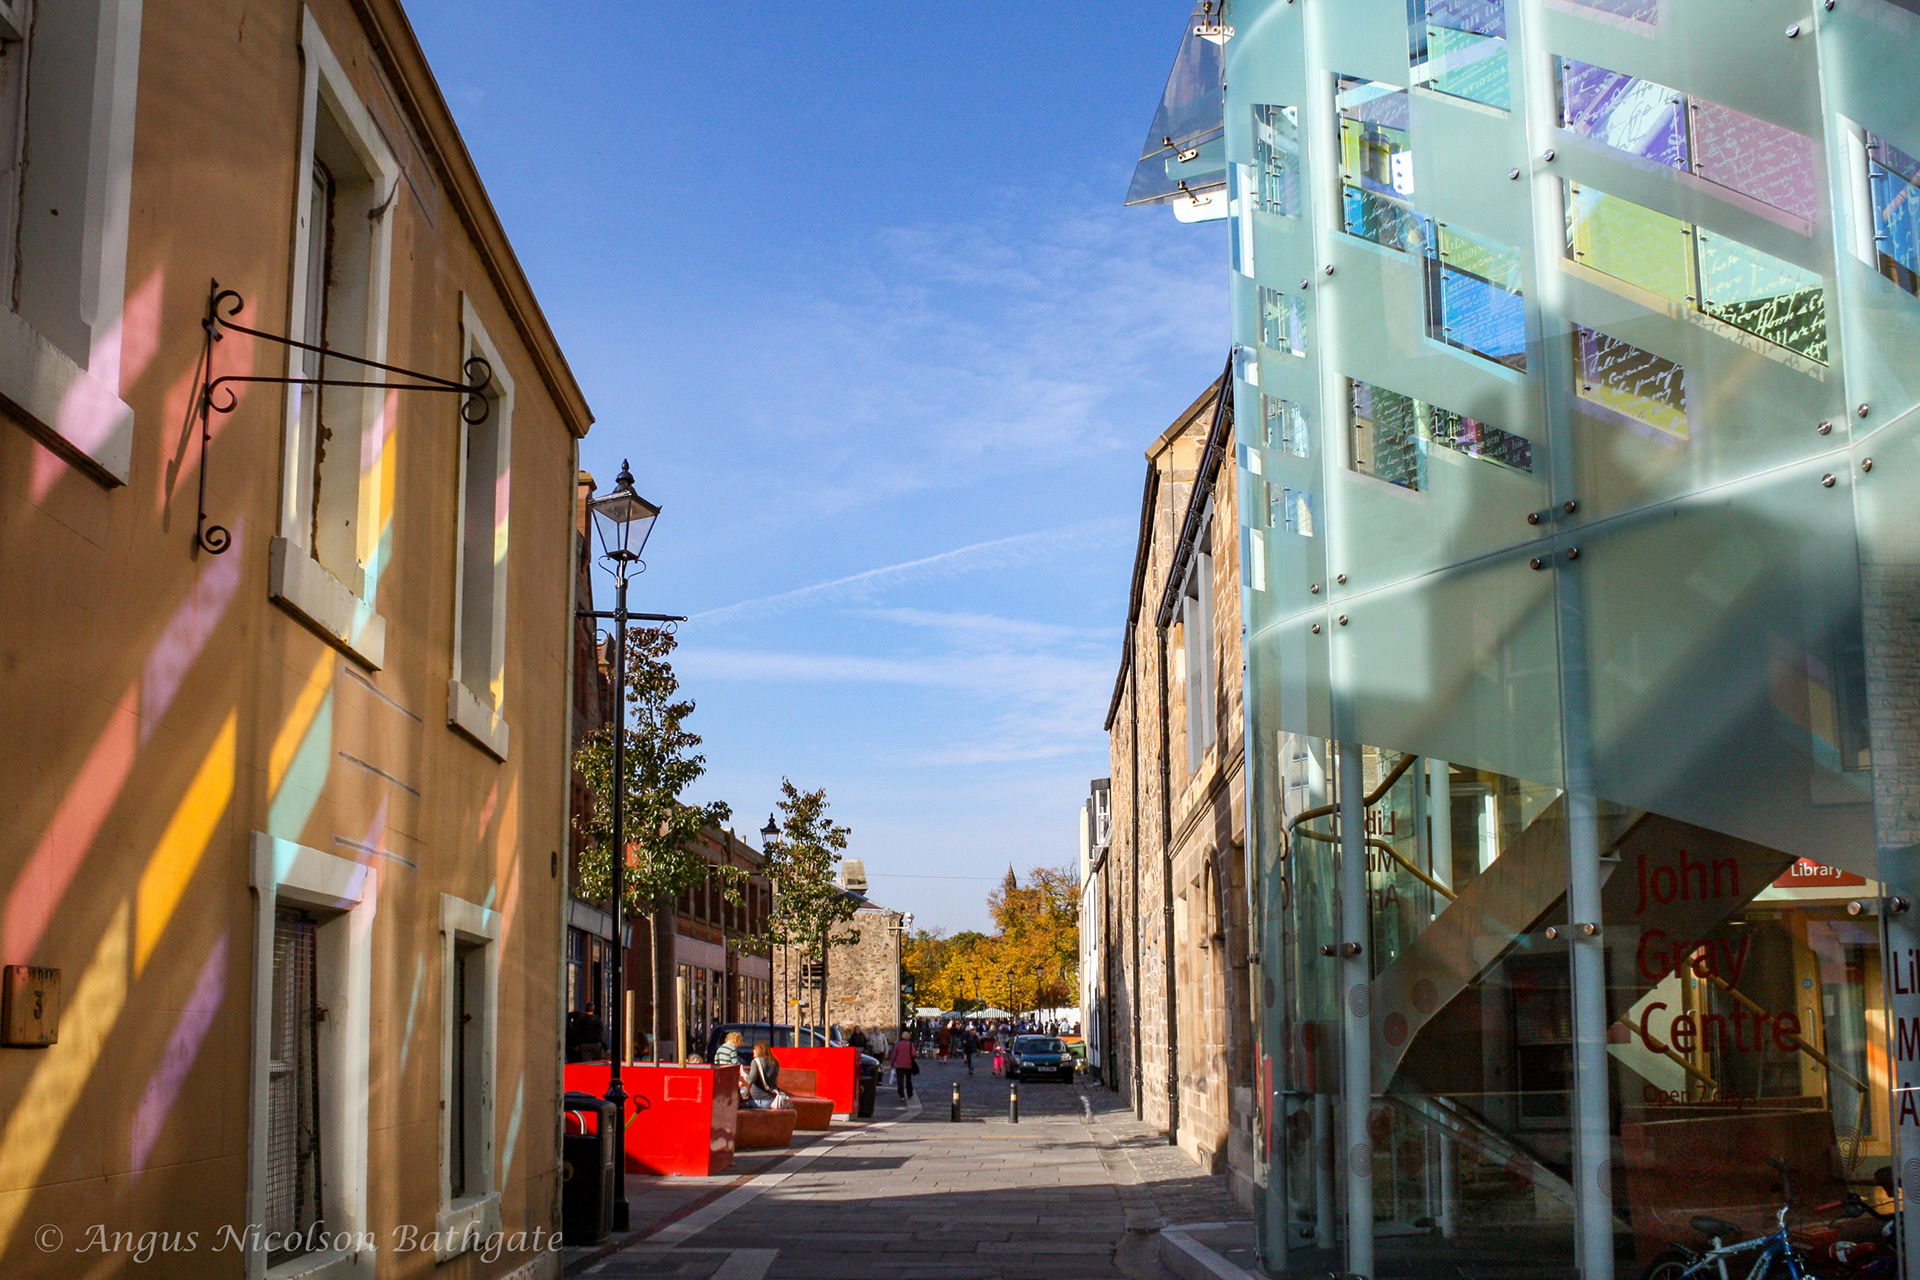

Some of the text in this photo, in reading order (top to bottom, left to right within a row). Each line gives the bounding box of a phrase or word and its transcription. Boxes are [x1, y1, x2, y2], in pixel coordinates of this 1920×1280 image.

[1635, 849, 1741, 915] John
[1791, 863, 1842, 879] Library
[1637, 929, 1750, 991] Gray
[33, 989, 44, 1020] 3
[1640, 999, 1803, 1054] Centre
[1643, 1084, 1691, 1111] Open
[1696, 1085, 1707, 1103] 7
